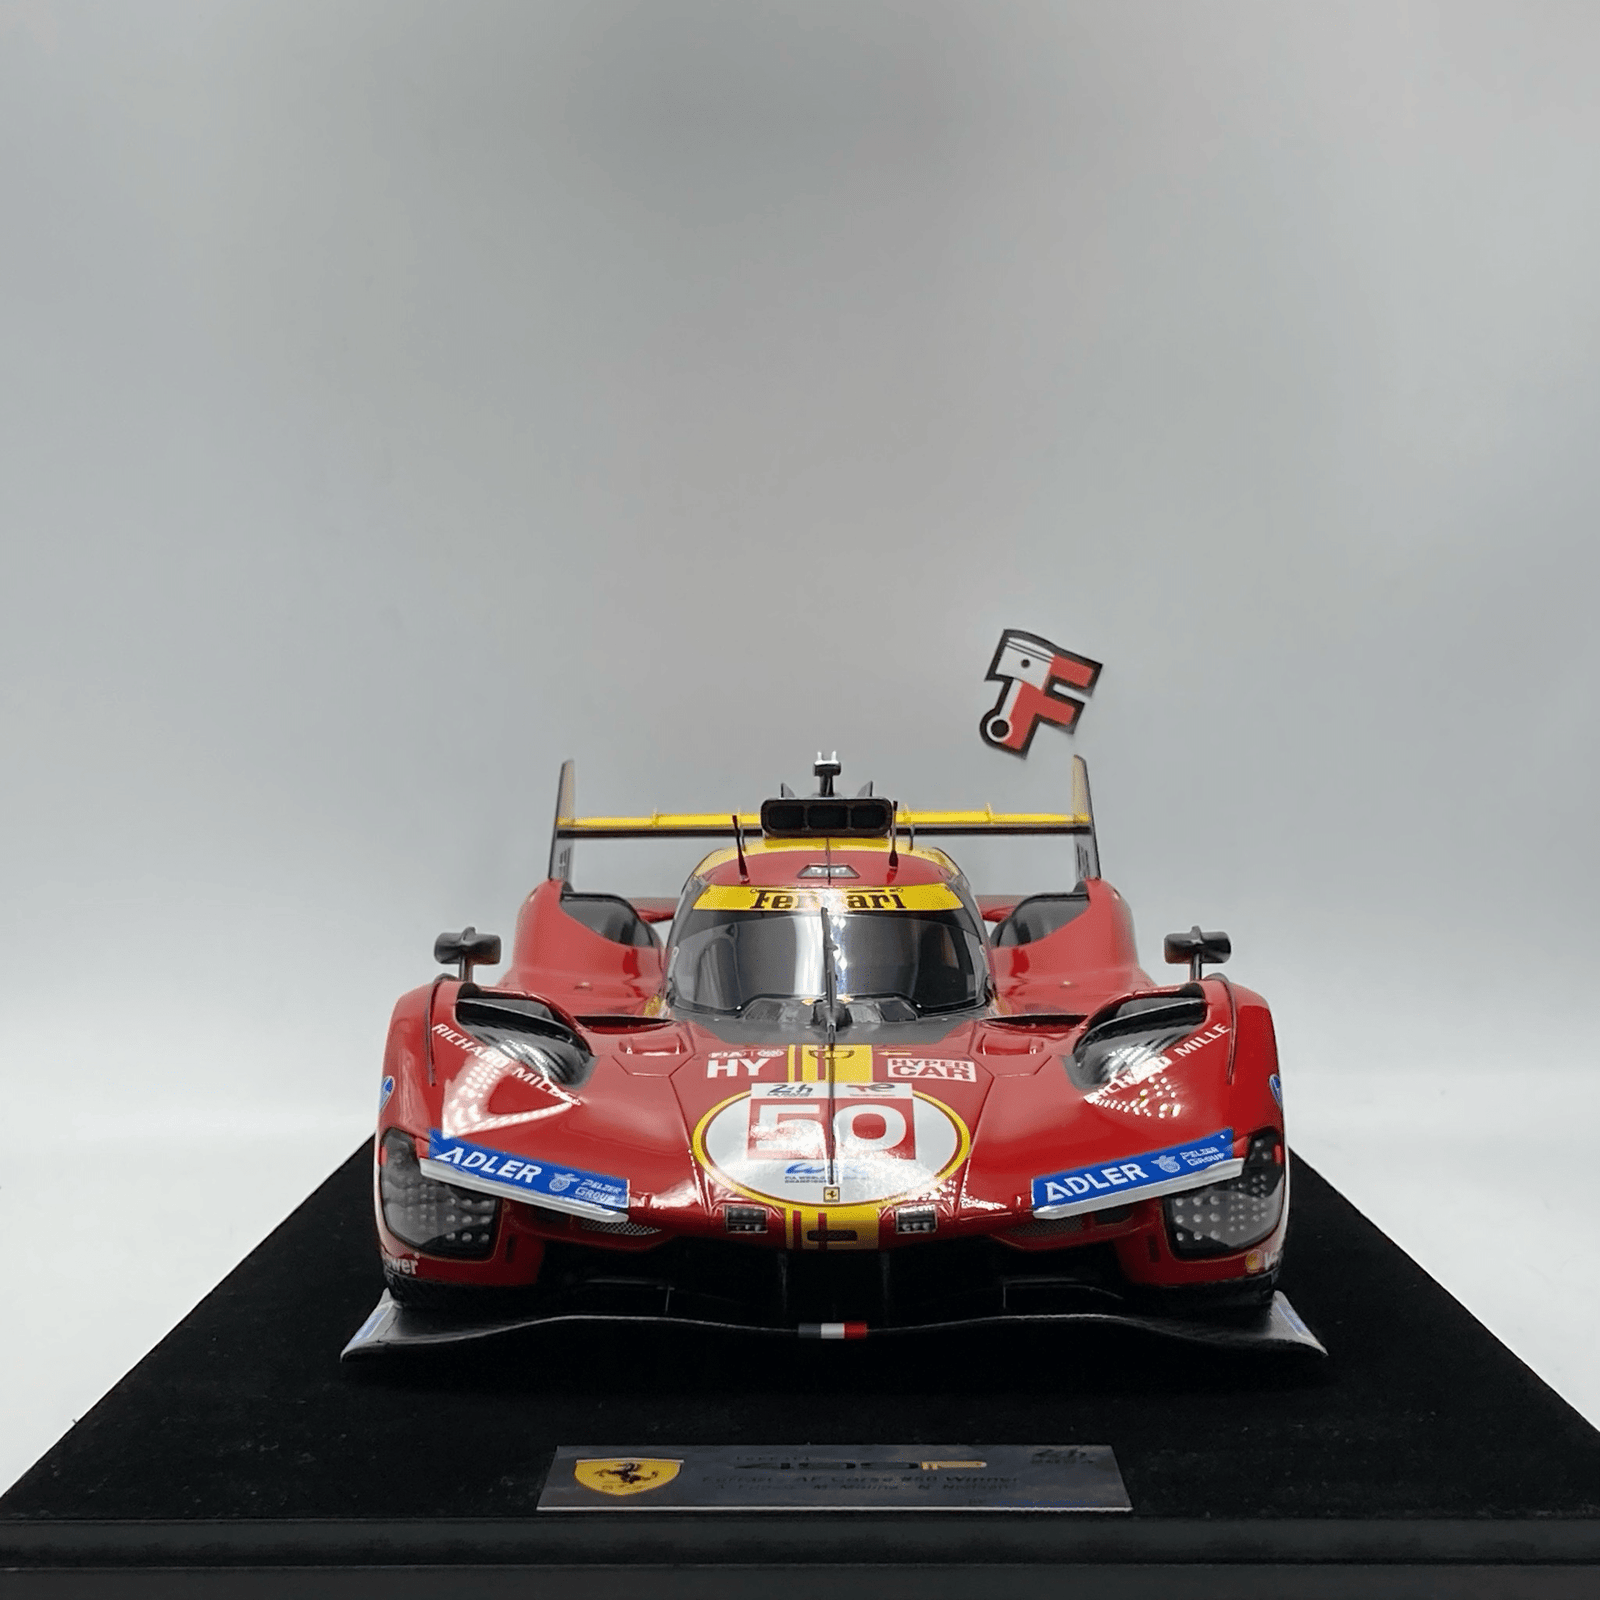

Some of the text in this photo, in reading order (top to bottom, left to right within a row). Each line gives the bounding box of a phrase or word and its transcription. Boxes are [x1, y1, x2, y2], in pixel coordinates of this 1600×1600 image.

[431, 1023, 510, 1069] RICHARD
[1174, 1022, 1231, 1058] MILLE
[706, 1058, 771, 1079] HY
[891, 1059, 969, 1069] HYPER
[892, 1065, 970, 1080] CAR
[755, 1104, 907, 1152] 50
[434, 1146, 543, 1185] ADLER
[1045, 1163, 1150, 1202] ADLER
